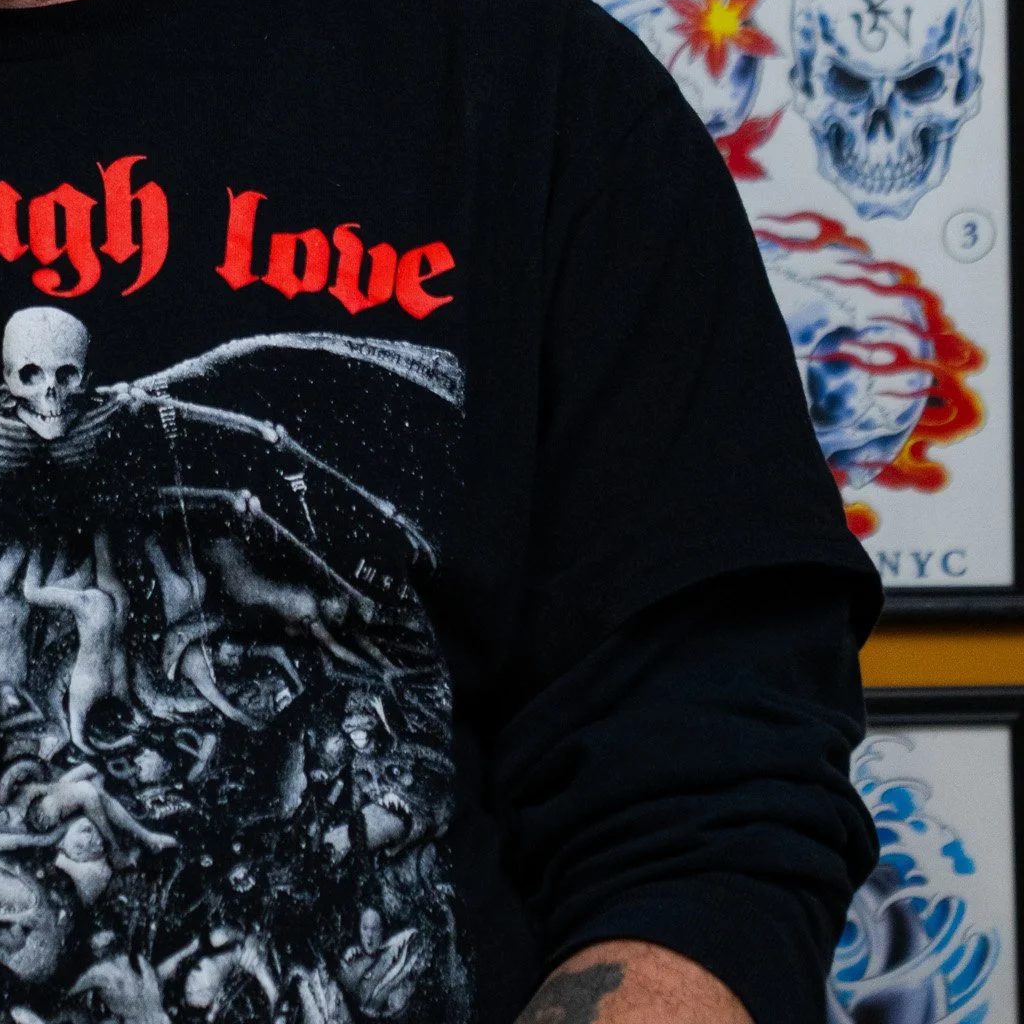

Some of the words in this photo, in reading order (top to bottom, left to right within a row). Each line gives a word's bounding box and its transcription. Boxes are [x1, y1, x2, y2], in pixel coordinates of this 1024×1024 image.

[961, 220, 979, 250] 3
[214, 186, 457, 320] love
[877, 548, 968, 578] NYC
